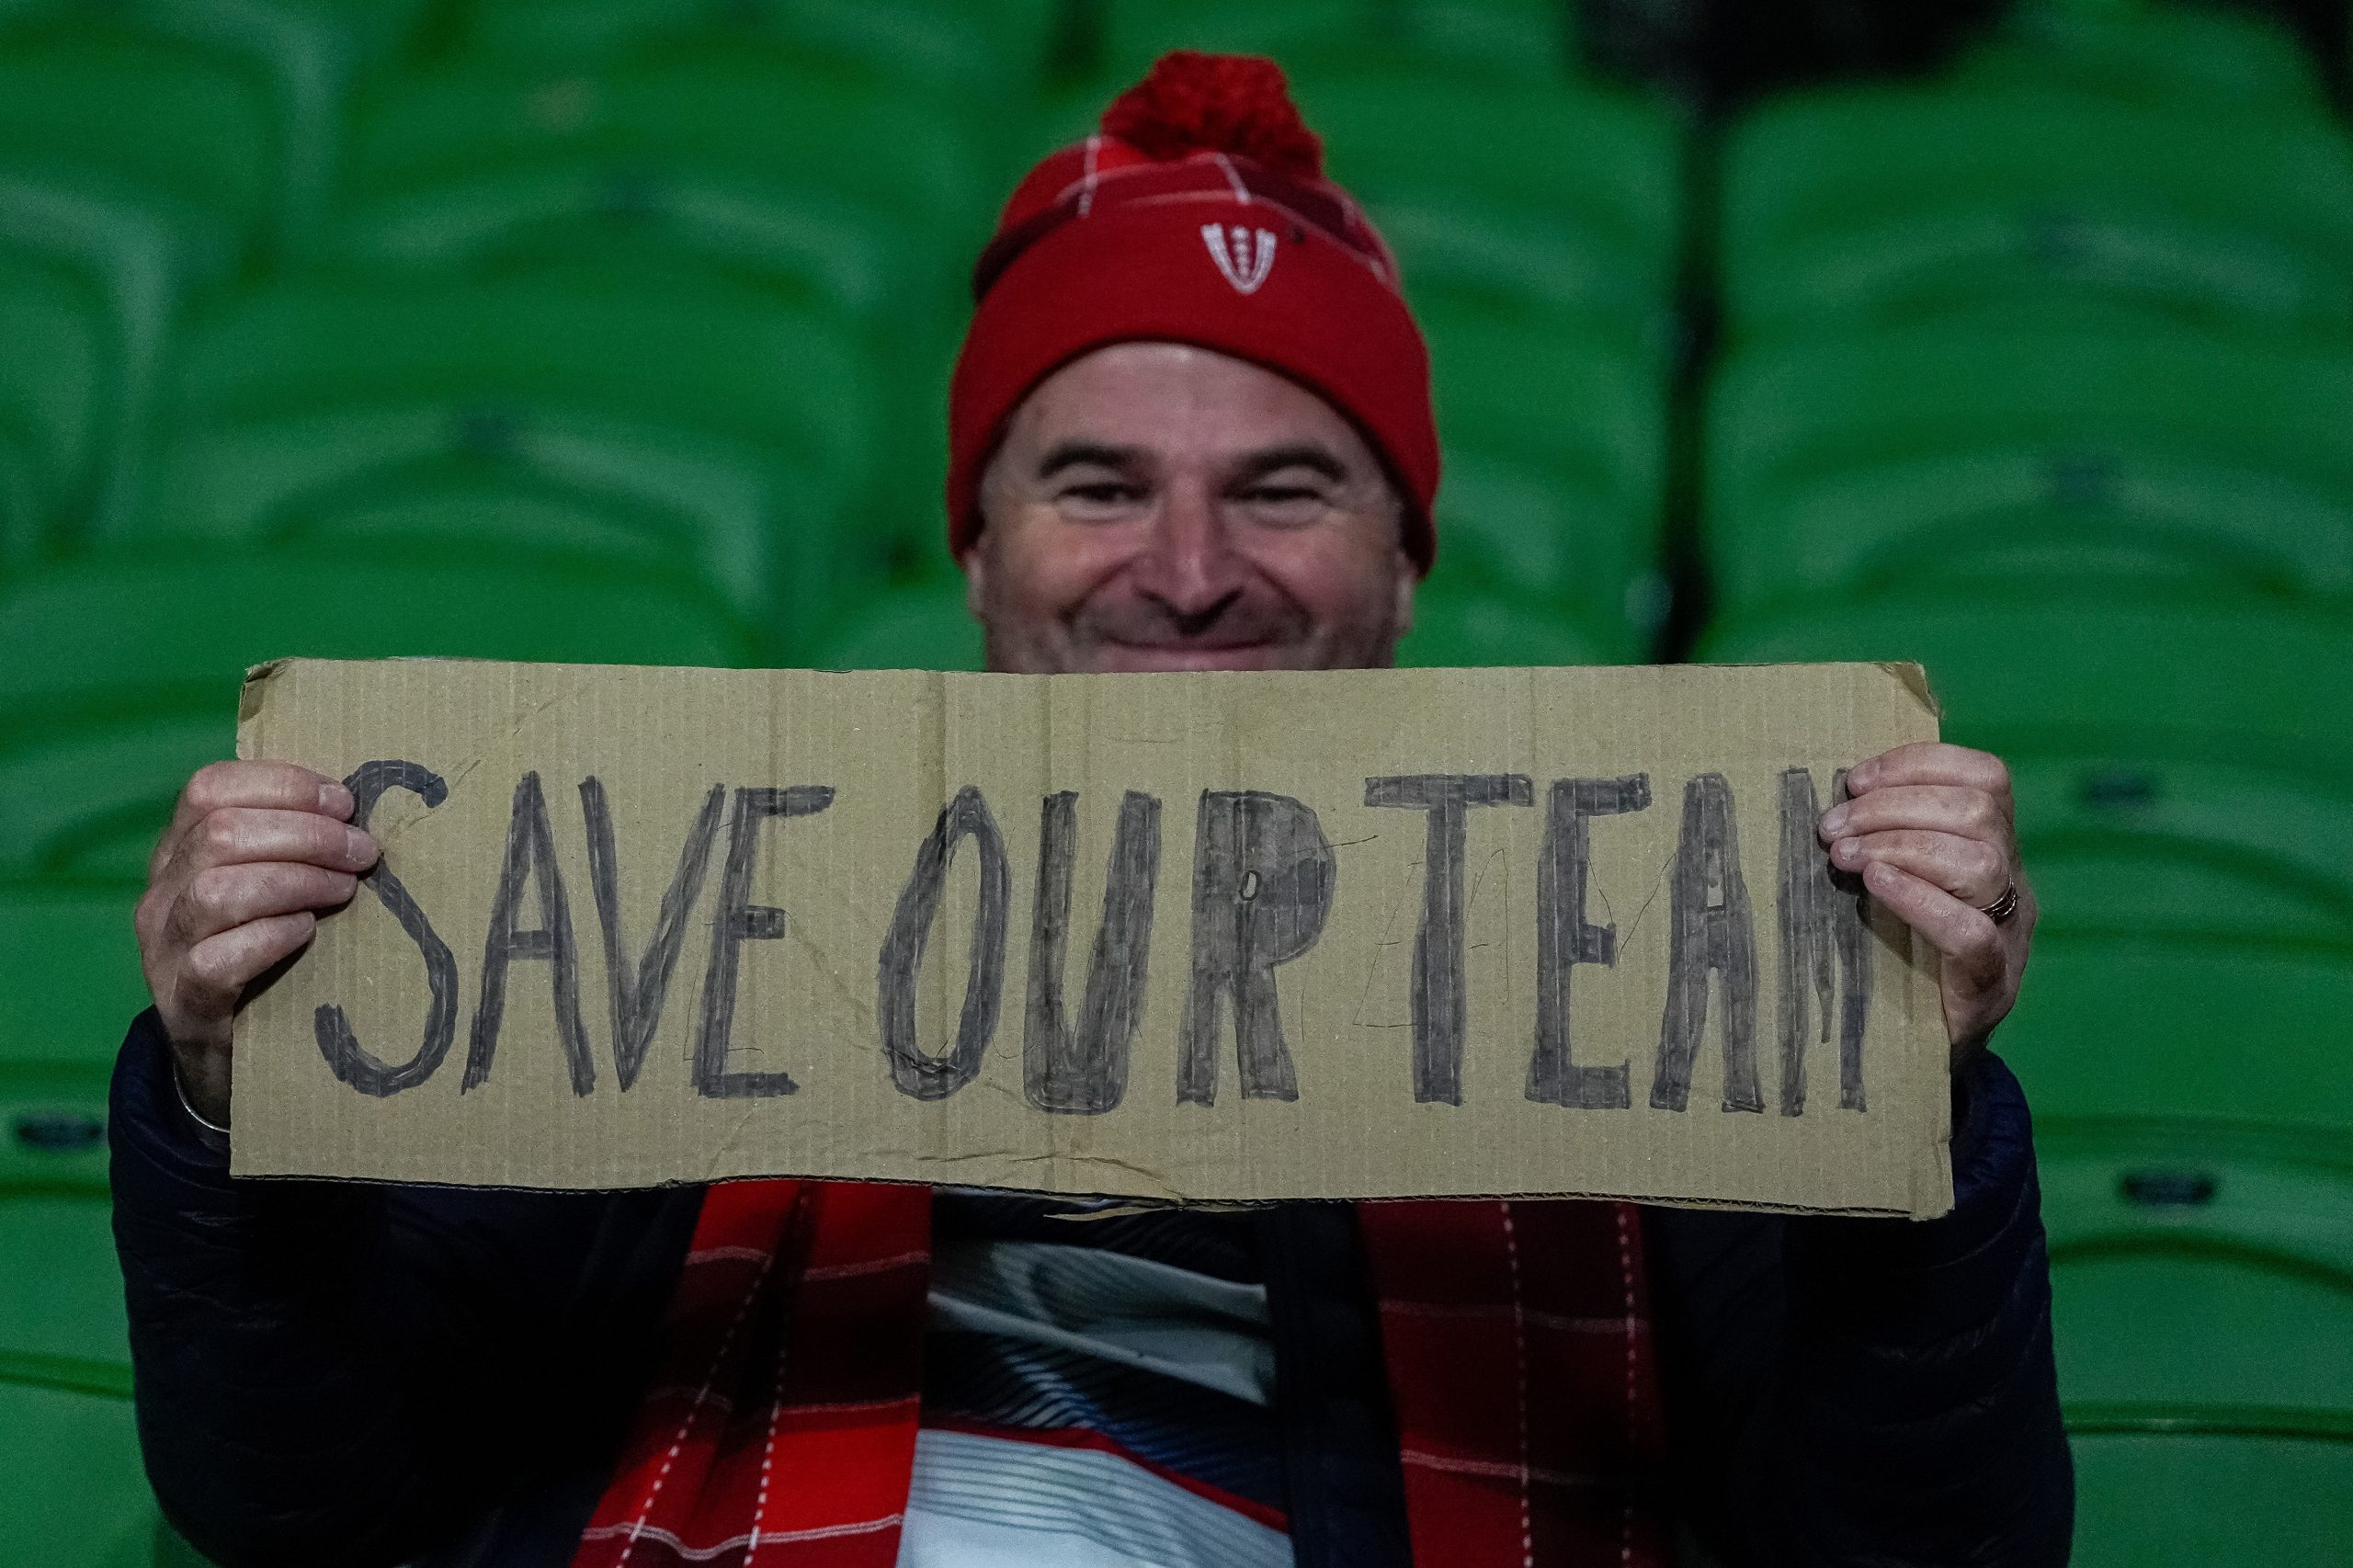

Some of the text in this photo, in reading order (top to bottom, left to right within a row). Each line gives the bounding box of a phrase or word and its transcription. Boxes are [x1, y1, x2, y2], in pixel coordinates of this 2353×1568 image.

[314, 759, 1875, 1117] SAVE OUR TEAM
